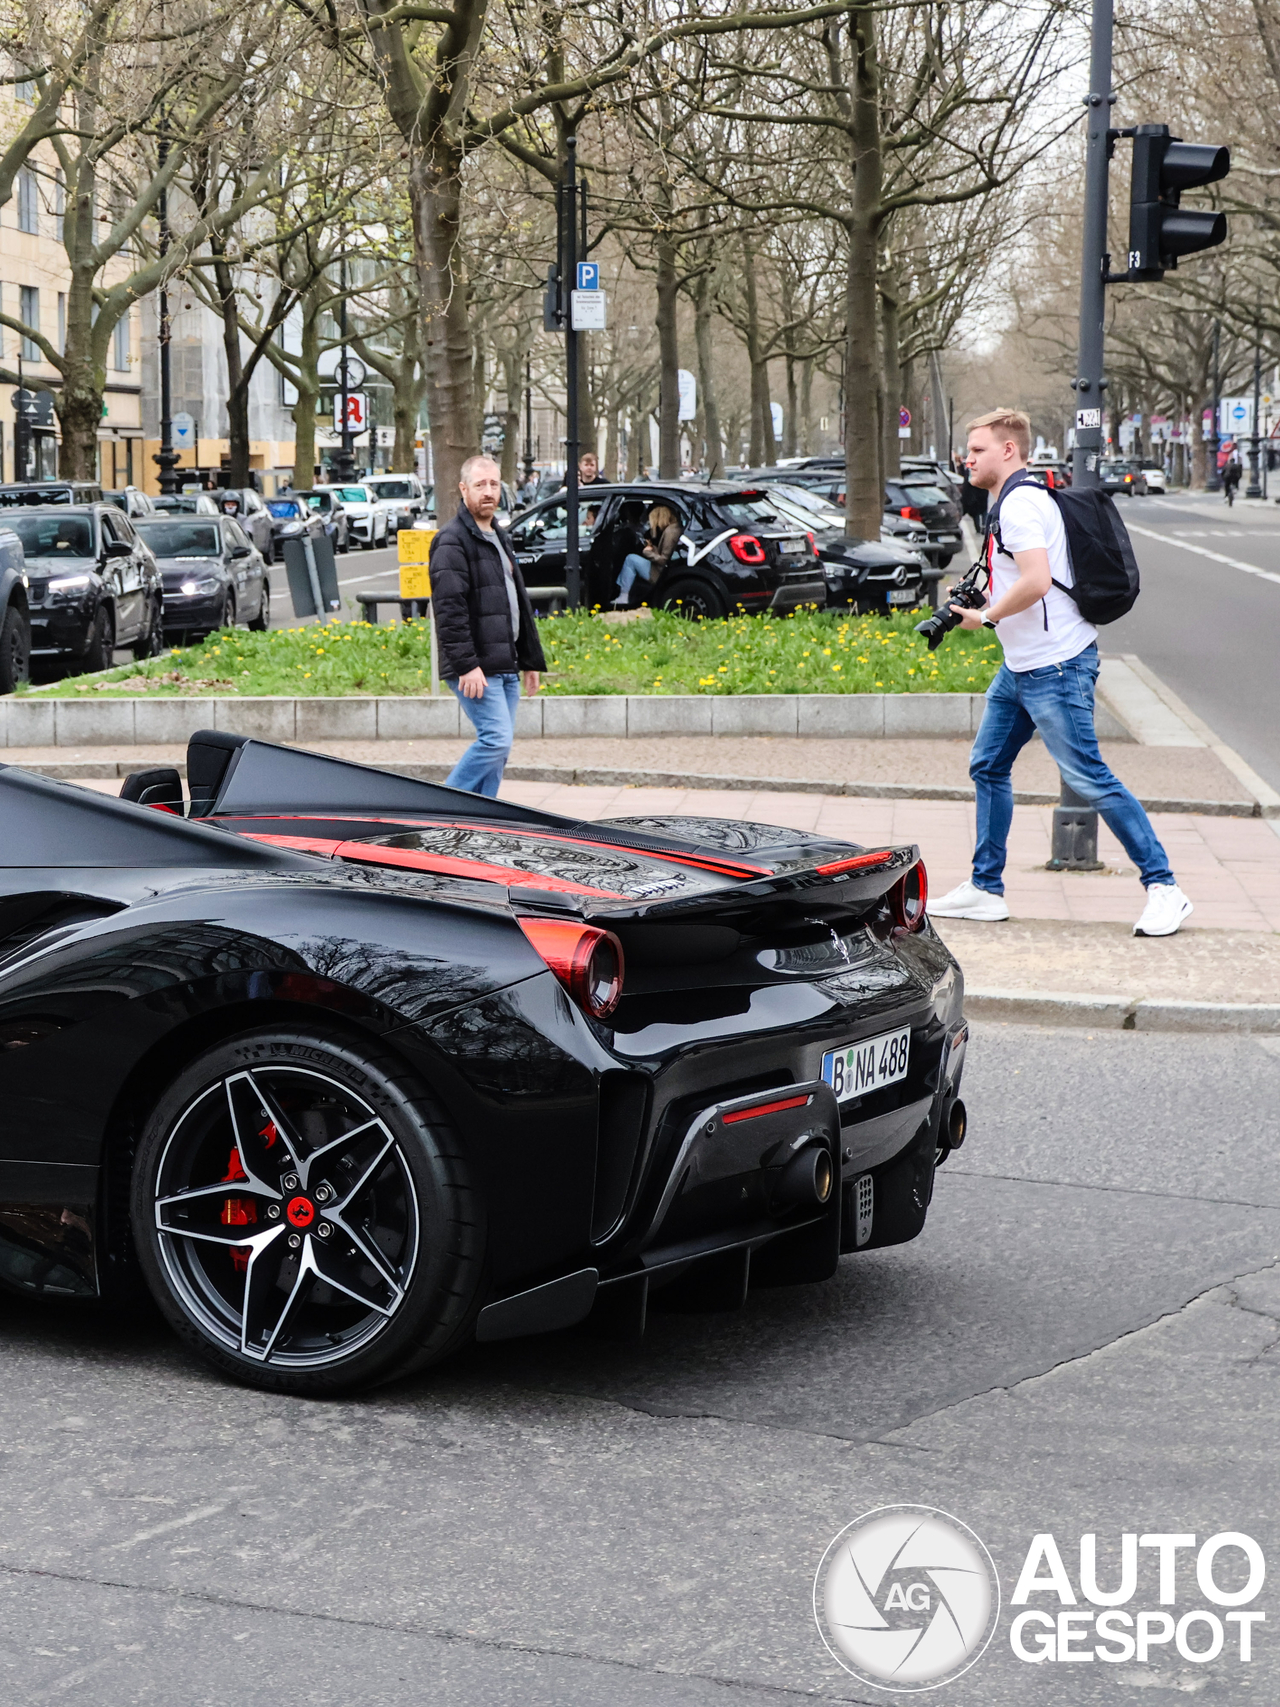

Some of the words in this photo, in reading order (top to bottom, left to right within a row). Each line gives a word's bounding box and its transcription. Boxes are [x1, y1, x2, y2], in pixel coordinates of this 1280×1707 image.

[1128, 250, 1141, 269] F3
[582, 265, 594, 287] P
[289, 1044, 367, 1086] MICHELIN
[833, 1056, 845, 1098] B
[855, 1045, 875, 1091] NA
[878, 1033, 908, 1080] 488
